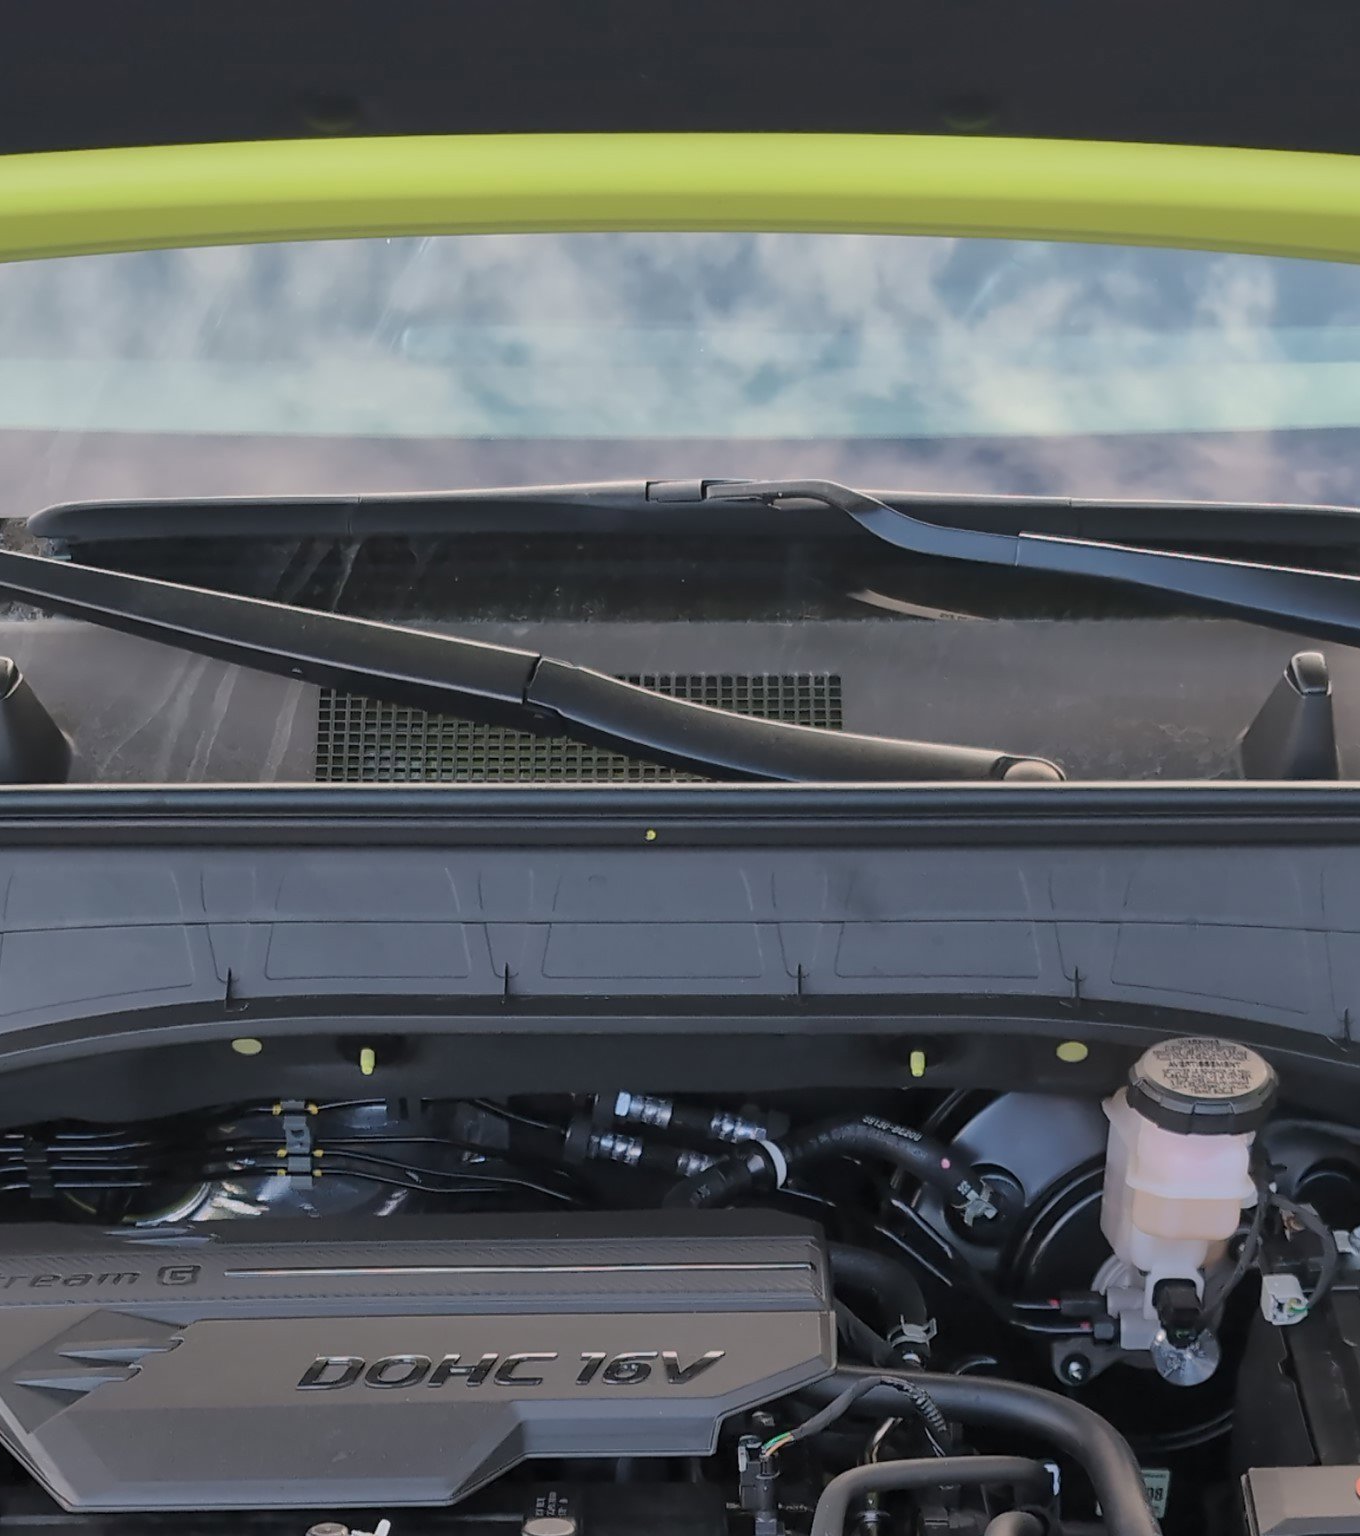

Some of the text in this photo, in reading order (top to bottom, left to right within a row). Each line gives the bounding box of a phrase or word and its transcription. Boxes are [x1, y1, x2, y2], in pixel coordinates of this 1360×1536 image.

[156, 1264, 202, 1287] G
[295, 1350, 727, 1390] DOHC 16V
